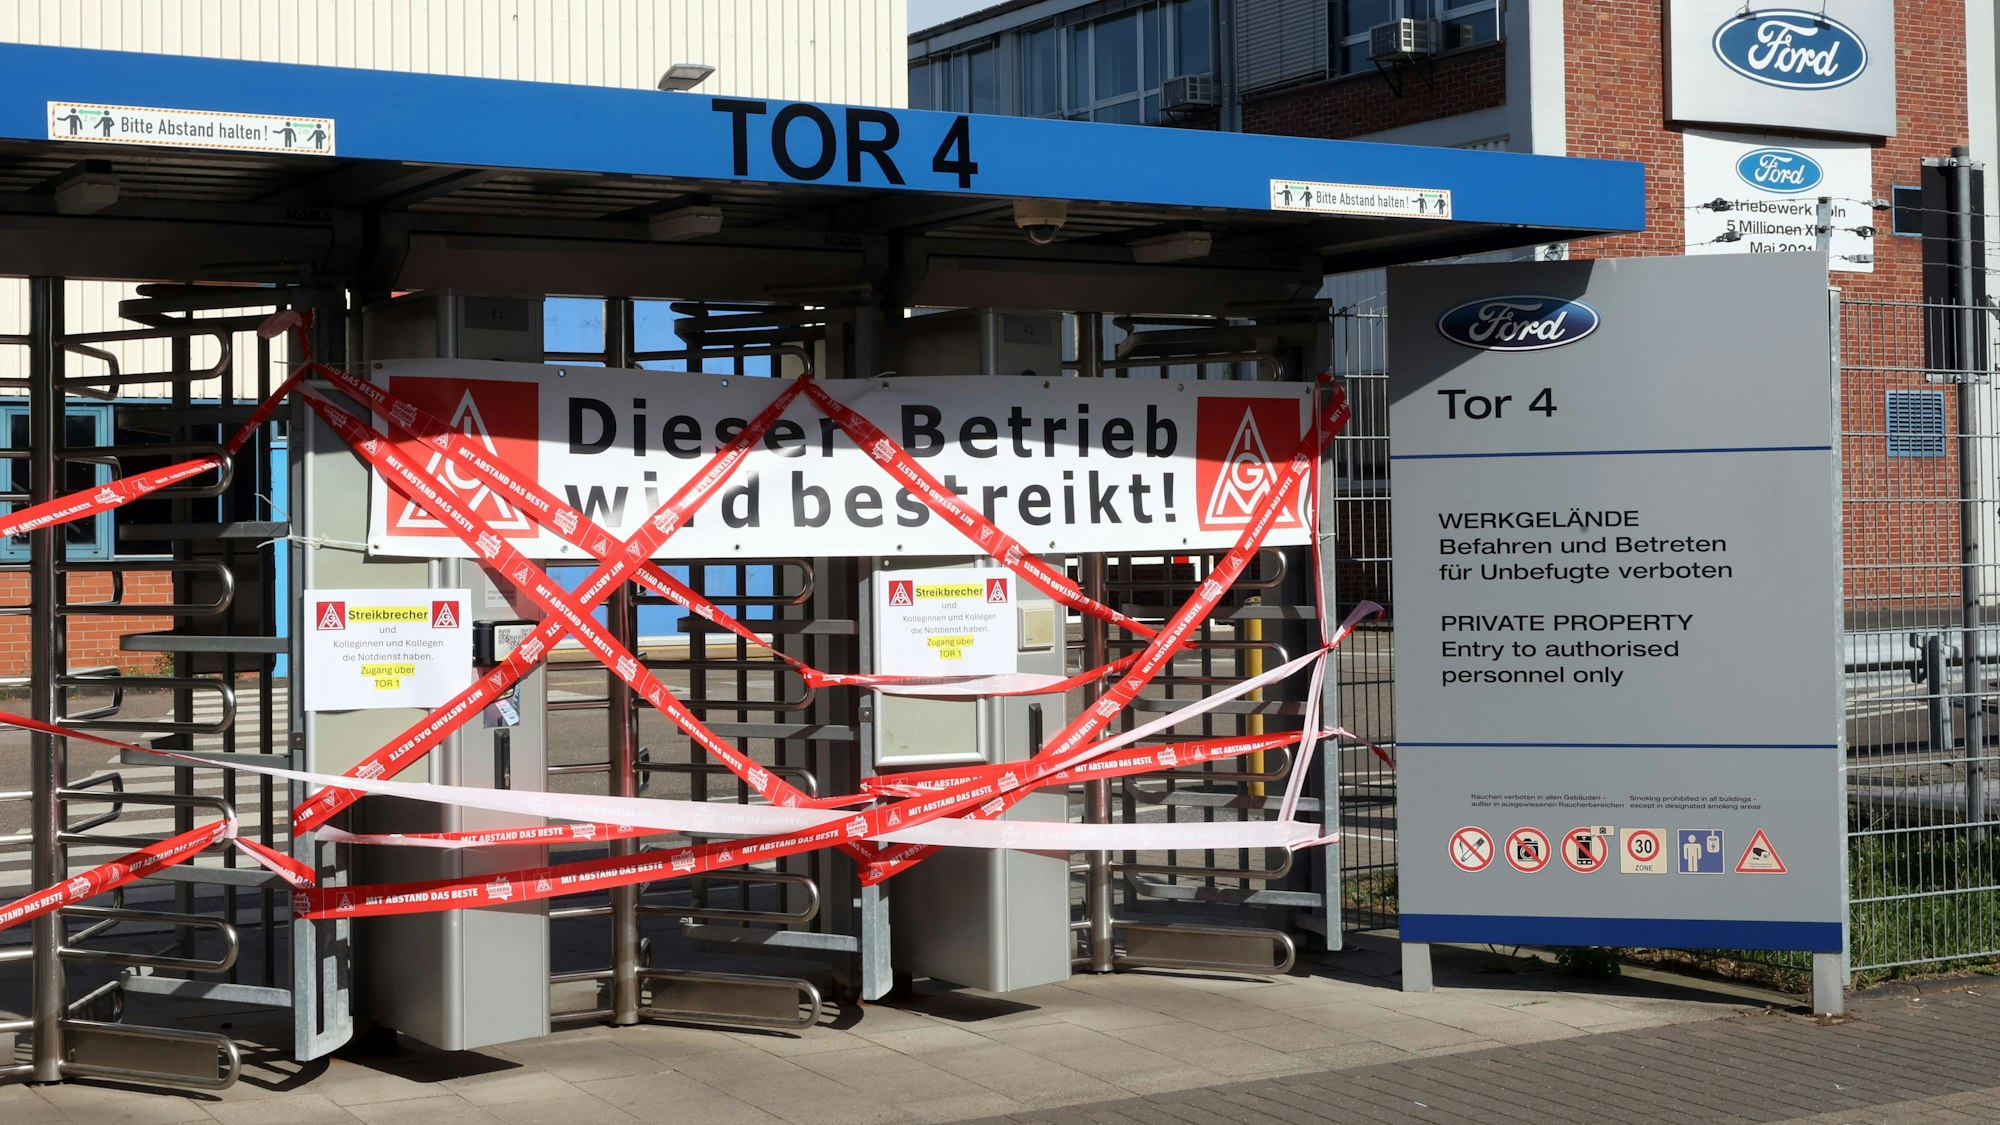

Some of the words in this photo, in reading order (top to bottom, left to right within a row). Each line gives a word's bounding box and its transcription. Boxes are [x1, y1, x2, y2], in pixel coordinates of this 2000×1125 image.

[1748, 20, 1840, 76] Ford
[121, 117, 153, 134] Bitte
[158, 119, 214, 138] Abstand
[712, 98, 906, 185] TOR
[933, 116, 978, 188] 4
[1755, 154, 1805, 184] Ford
[1317, 191, 1336, 204] Bitte
[1340, 193, 1375, 206] Abstand
[1728, 198, 1812, 215] etriebewerk
[1727, 220, 1736, 232] 5
[1740, 220, 1801, 236] Millionen
[1751, 242, 1775, 252] Mai
[1469, 303, 1567, 342] Ford
[1438, 389, 1512, 419] Tor
[1529, 388, 1557, 417] 4
[568, 397, 843, 460] Dieser
[900, 403, 1178, 459] Betrieb
[459, 447, 475, 461] MIT
[474, 458, 510, 485] ABSTAND
[509, 482, 526, 496] DAS
[525, 493, 550, 512] BESTE
[896, 461, 918, 481] BESTE
[386, 456, 401, 471] MIT
[401, 468, 436, 499] ABSTAND
[435, 497, 451, 513] DAS
[451, 510, 475, 533] BESTE
[564, 470, 760, 529] wid
[929, 489, 962, 520] ABSTAND
[1439, 508, 1639, 529] WERKGELÄNDE
[1440, 538, 1552, 555] Befahren
[1561, 537, 1606, 554] und
[1616, 536, 1727, 553] Betreten
[610, 561, 625, 577] MIT
[1439, 564, 1472, 580] für
[1481, 563, 1610, 584] Unbefugte
[1618, 562, 1733, 579] verboten
[580, 574, 611, 604] ABSTAND
[915, 587, 983, 597] Streikbrecher
[671, 591, 691, 608] BESTE
[349, 610, 428, 620] Streikbrecher
[536, 584, 549, 599] MIT
[550, 597, 581, 626] ABSTAND
[580, 624, 595, 639] DAS
[593, 636, 614, 658] BESTE
[903, 615, 946, 623] Kolleginnen
[965, 613, 996, 622] Kollegen
[1441, 615, 1545, 631] PRIVATE
[1554, 614, 1693, 631] PROPERTY
[924, 626, 961, 634] Notdienst
[963, 625, 990, 633] haben.
[1152, 635, 1177, 662] ABSTAND
[1185, 603, 1202, 624] BESTE
[333, 640, 383, 649] Kolleginnen
[405, 639, 443, 648] Kollegen
[927, 638, 955, 647] Zugang
[956, 637, 974, 645] über
[1442, 641, 1505, 661] Entry
[1512, 642, 1536, 657] to
[1545, 640, 1679, 657] authorised
[358, 653, 400, 661] Notdienst
[403, 653, 434, 661] haben.
[361, 666, 392, 676] Zugang
[395, 666, 415, 674] über
[1442, 666, 1564, 686] personnel
[1573, 666, 1624, 686] only
[375, 680, 393, 688] TOR
[468, 689, 483, 705] MIT
[431, 702, 467, 731] ABSTAND
[414, 728, 432, 744] DAS
[668, 705, 682, 719] MIT
[680, 717, 709, 744] ABSTAND
[722, 752, 743, 771] BESTE
[389, 740, 415, 761] BESTE
[1088, 760, 1118, 771] ABSTAND
[1132, 756, 1152, 765] BESTE
[908, 806, 921, 816] MIT
[921, 797, 956, 811] ABSTAND
[956, 790, 972, 803] DAS
[971, 785, 993, 797] BESTE
[519, 829, 536, 839] DAS
[536, 827, 564, 837] BESTE
[847, 819, 866, 829] ZUKUNFT
[847, 825, 867, 834] SICHERN
[742, 844, 757, 855] MIT
[758, 838, 797, 852] ABSTAND
[797, 835, 814, 845] DAS
[815, 829, 840, 841] BESTE
[1635, 839, 1652, 853] 30
[561, 875, 577, 885] MIT
[579, 869, 618, 882] ABSTAND
[619, 865, 637, 875] DAS
[638, 861, 664, 873] BESTE
[41, 891, 64, 907] BESTE
[366, 896, 384, 905] MIT
[385, 893, 429, 904] ABSTAND
[431, 891, 450, 901] DAS
[451, 888, 479, 899] BESTE
